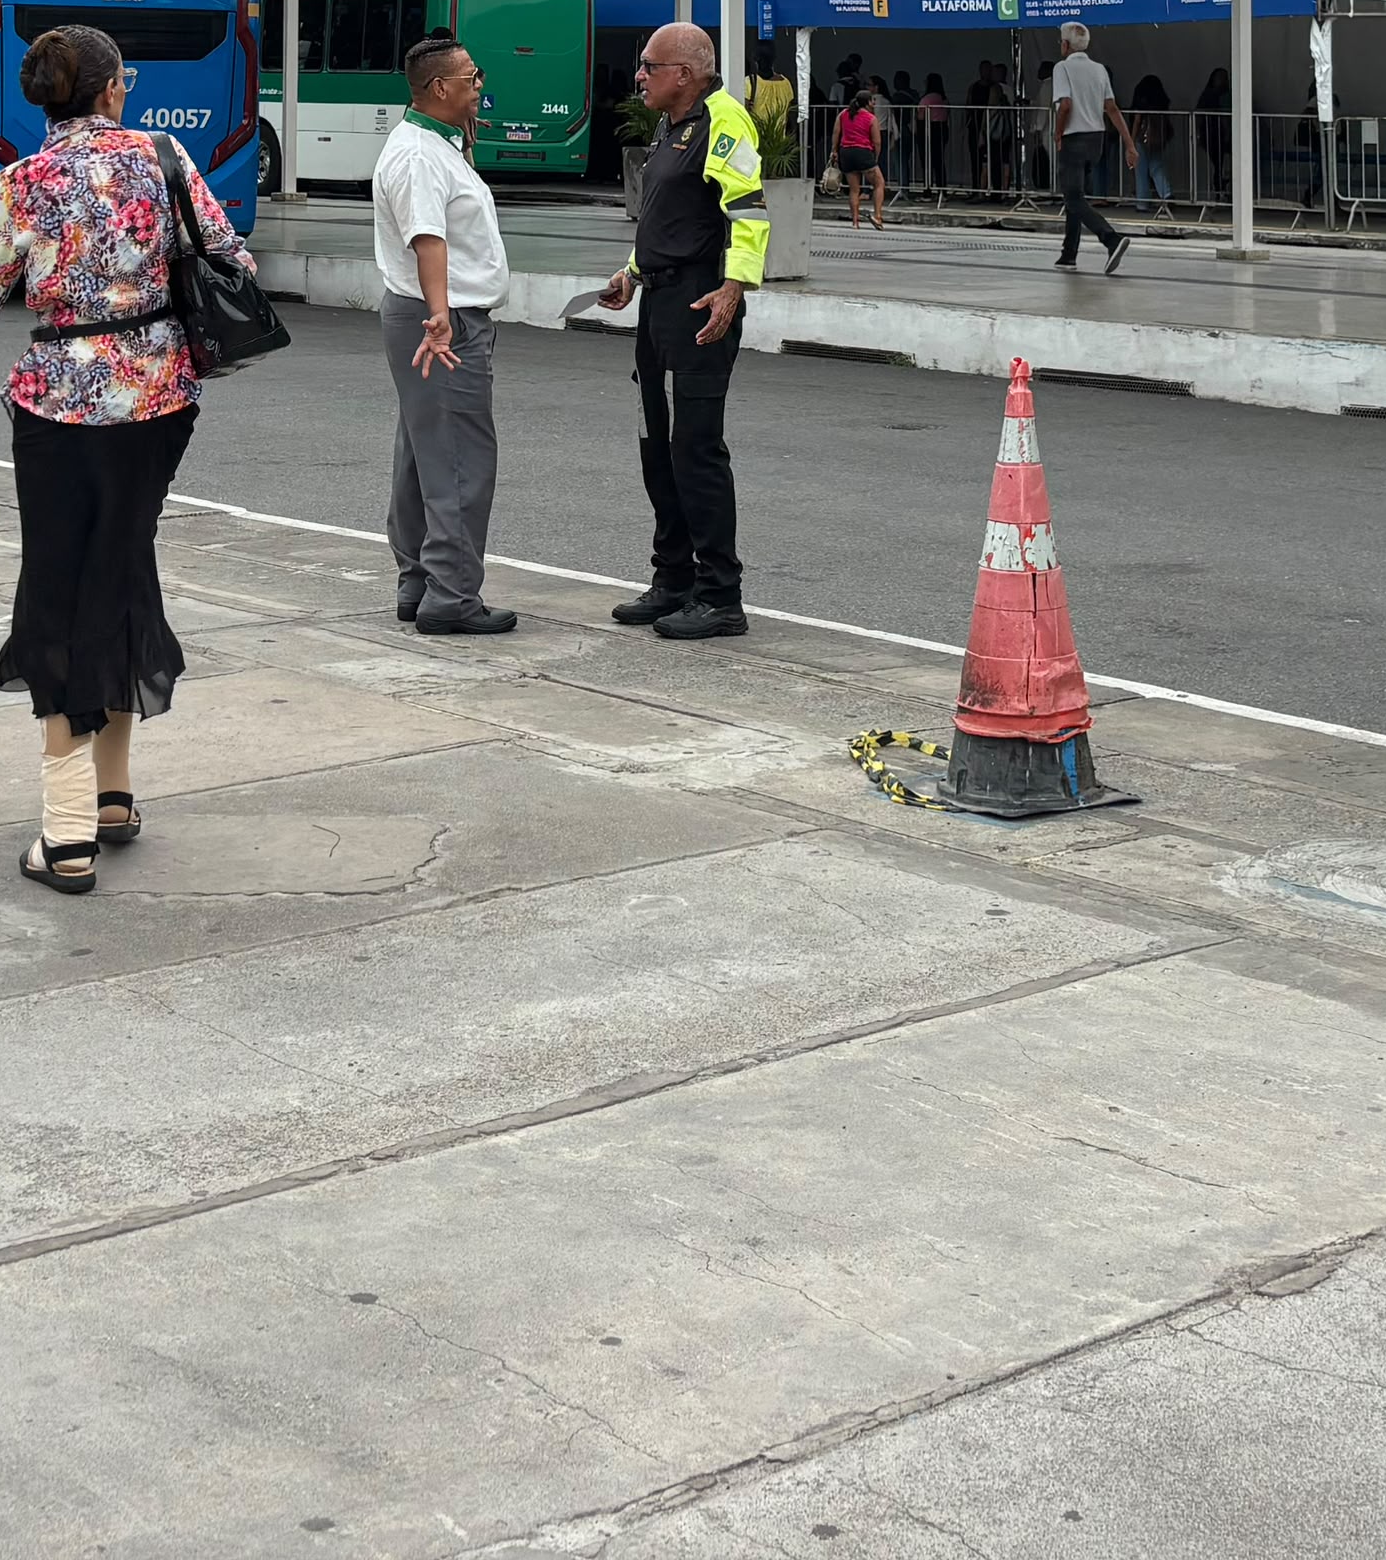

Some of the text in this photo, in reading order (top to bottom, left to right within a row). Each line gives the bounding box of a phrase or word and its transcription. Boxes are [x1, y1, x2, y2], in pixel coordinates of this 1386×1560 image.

[876, 0, 883, 13] F
[922, 0, 993, 12] PLATAFORMA
[541, 103, 569, 114] 21441
[139, 107, 212, 129] 40057
